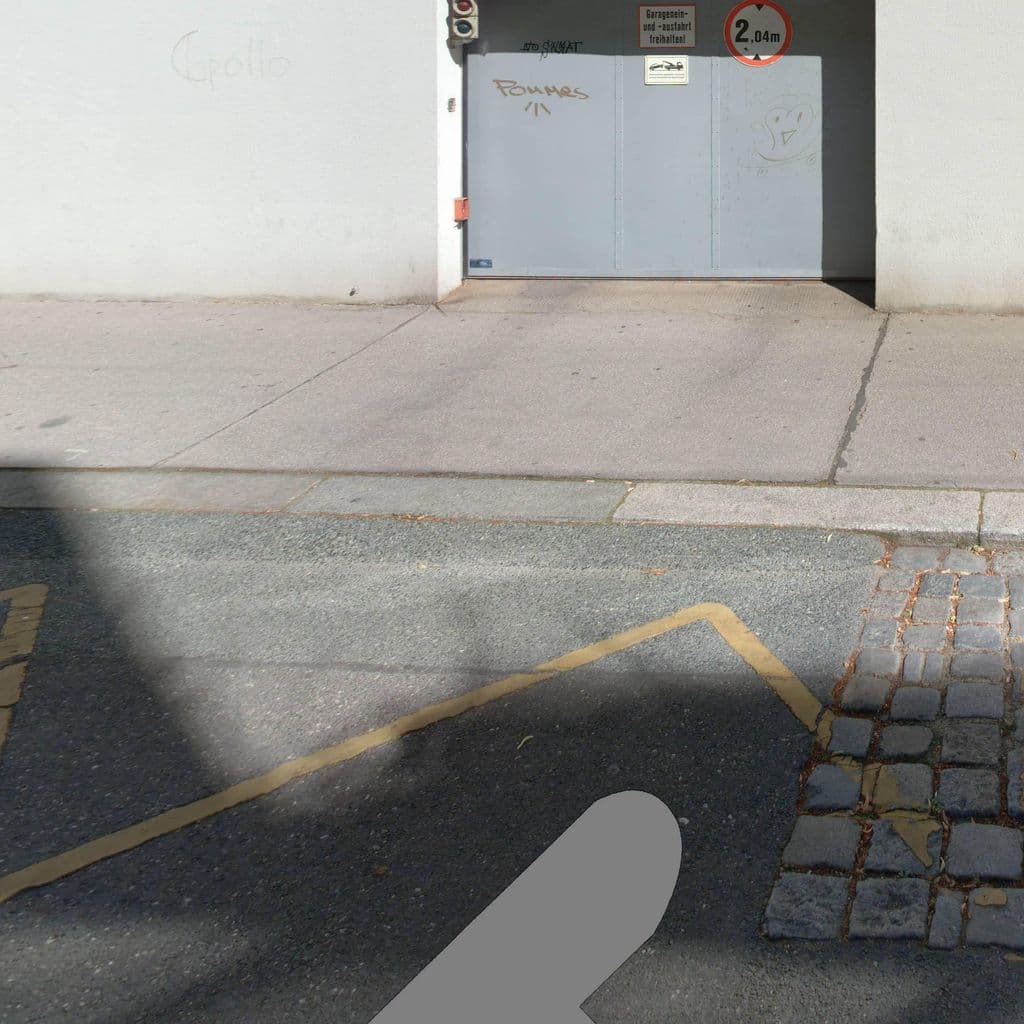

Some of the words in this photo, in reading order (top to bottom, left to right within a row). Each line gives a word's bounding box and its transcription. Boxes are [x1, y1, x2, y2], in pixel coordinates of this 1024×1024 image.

[646, 9, 689, 20] Garagenein-
[643, 22, 656, 32] und
[658, 21, 692, 32] -ausfahrt
[649, 34, 686, 44] freihalten!
